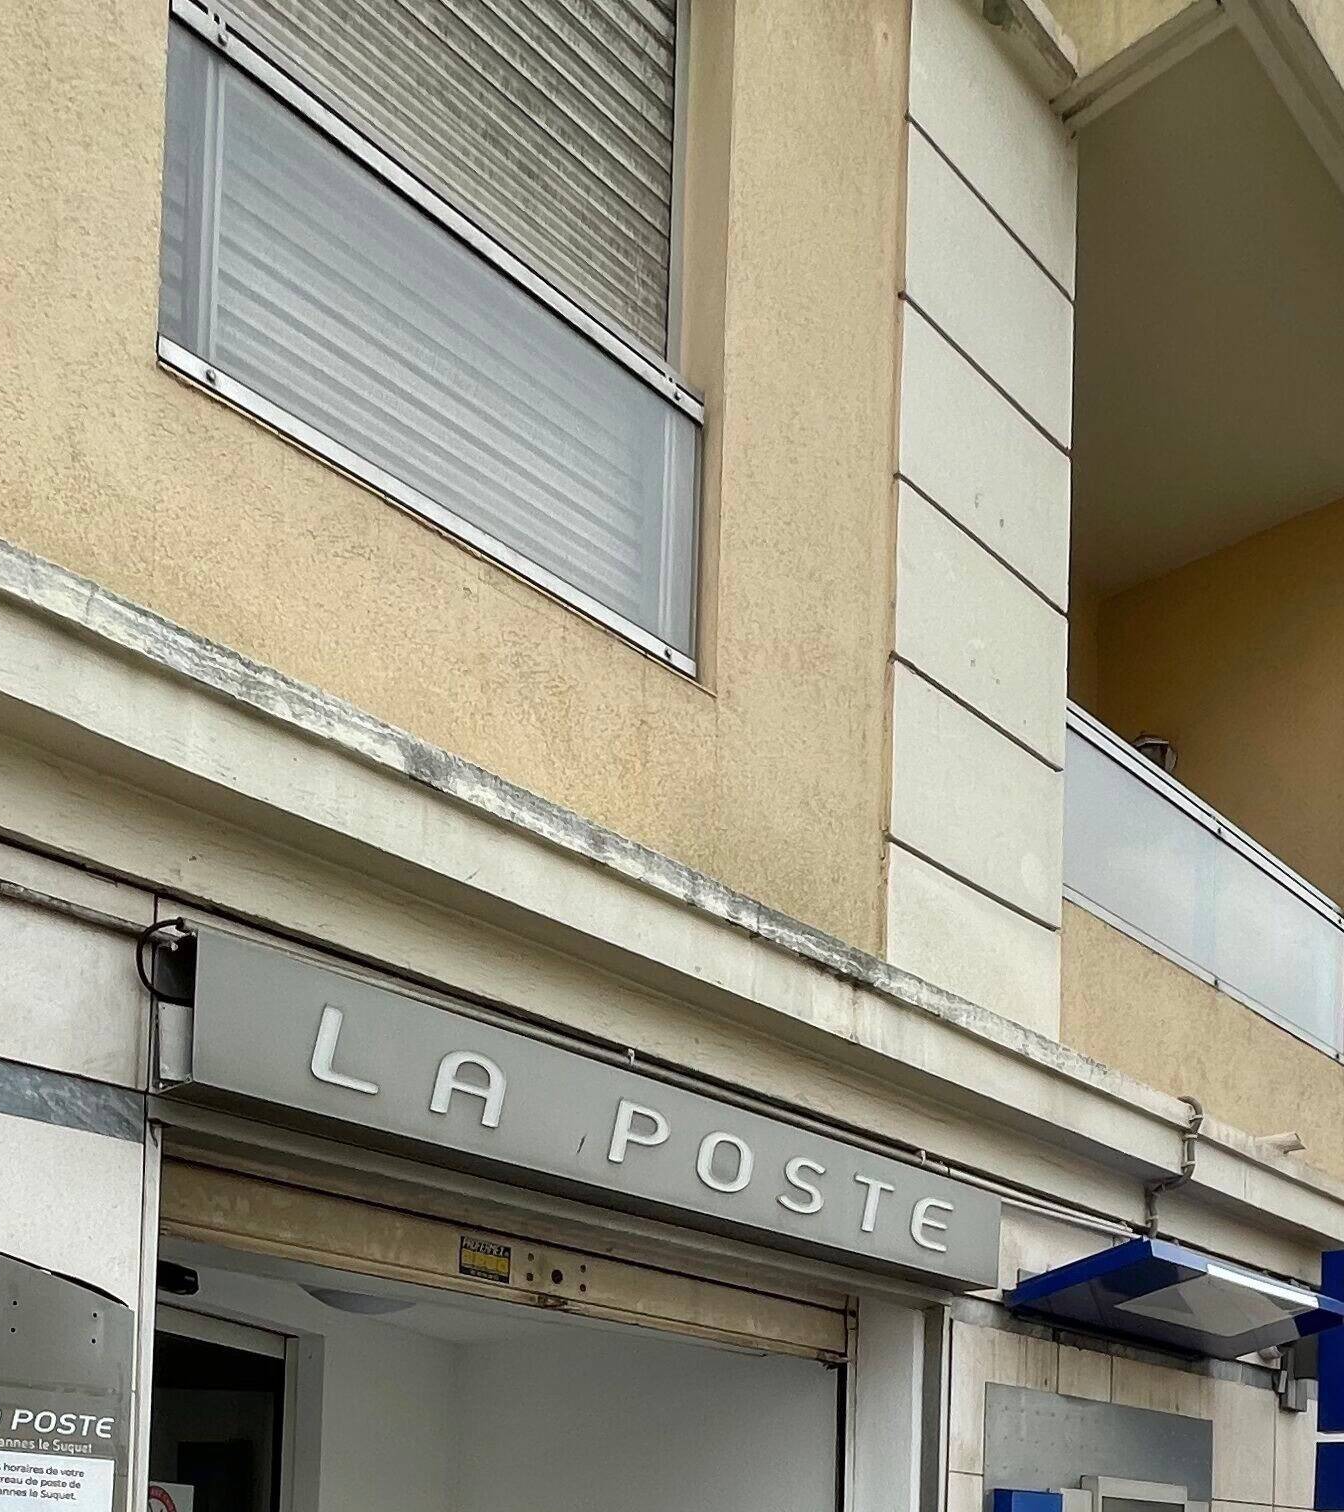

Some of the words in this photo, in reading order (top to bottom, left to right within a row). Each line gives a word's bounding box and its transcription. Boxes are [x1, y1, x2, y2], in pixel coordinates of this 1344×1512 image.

[310, 1003, 508, 1128] LA
[606, 1098, 955, 1253] POSTE
[11, 1408, 115, 1439] POSTE
[38, 1438, 49, 1450] le
[53, 1439, 92, 1454] Suquet
[3, 1462, 44, 1475] horaires
[46, 1466, 58, 1475] de
[60, 1468, 84, 1478] votre
[25, 1476, 38, 1486] de
[40, 1478, 67, 1488] poste
[68, 1480, 81, 1489] de
[29, 1488, 38, 1498] le
